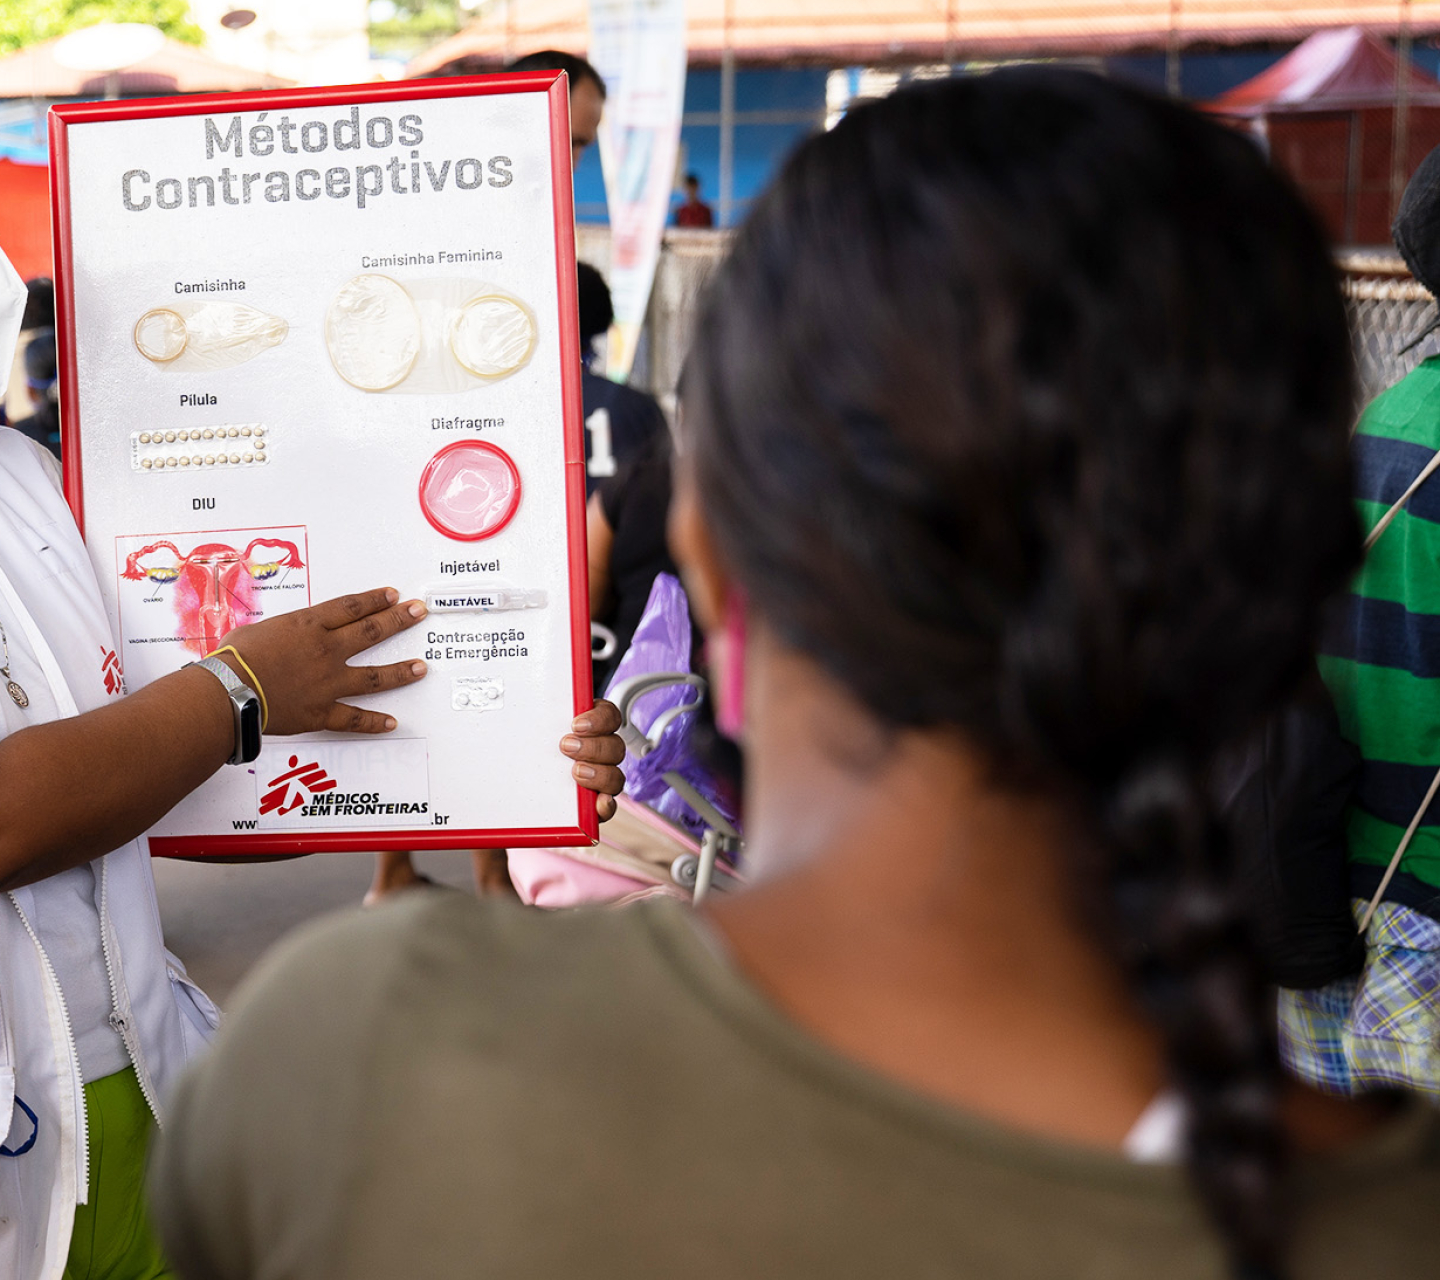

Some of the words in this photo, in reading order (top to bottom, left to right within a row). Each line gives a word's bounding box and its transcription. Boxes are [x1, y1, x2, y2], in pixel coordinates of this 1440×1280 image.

[204, 106, 424, 160] Métodos
[122, 151, 513, 212] Contraceptivos
[361, 253, 434, 269] Camisinha
[438, 248, 503, 264] Feminina
[174, 278, 246, 294] Camisinha
[179, 393, 218, 407] Pílula
[431, 416, 505, 432] Diafragma
[585, 407, 617, 478] 1
[192, 497, 216, 511] DIU
[435, 596, 495, 607] INJETÁVEL
[427, 628, 525, 645] Contracepção
[425, 647, 442, 661] de
[445, 644, 529, 662] Emergência
[312, 791, 380, 805] MÉDICOS
[301, 804, 331, 817] SEM
[334, 802, 429, 816] FRONTEIRAS
